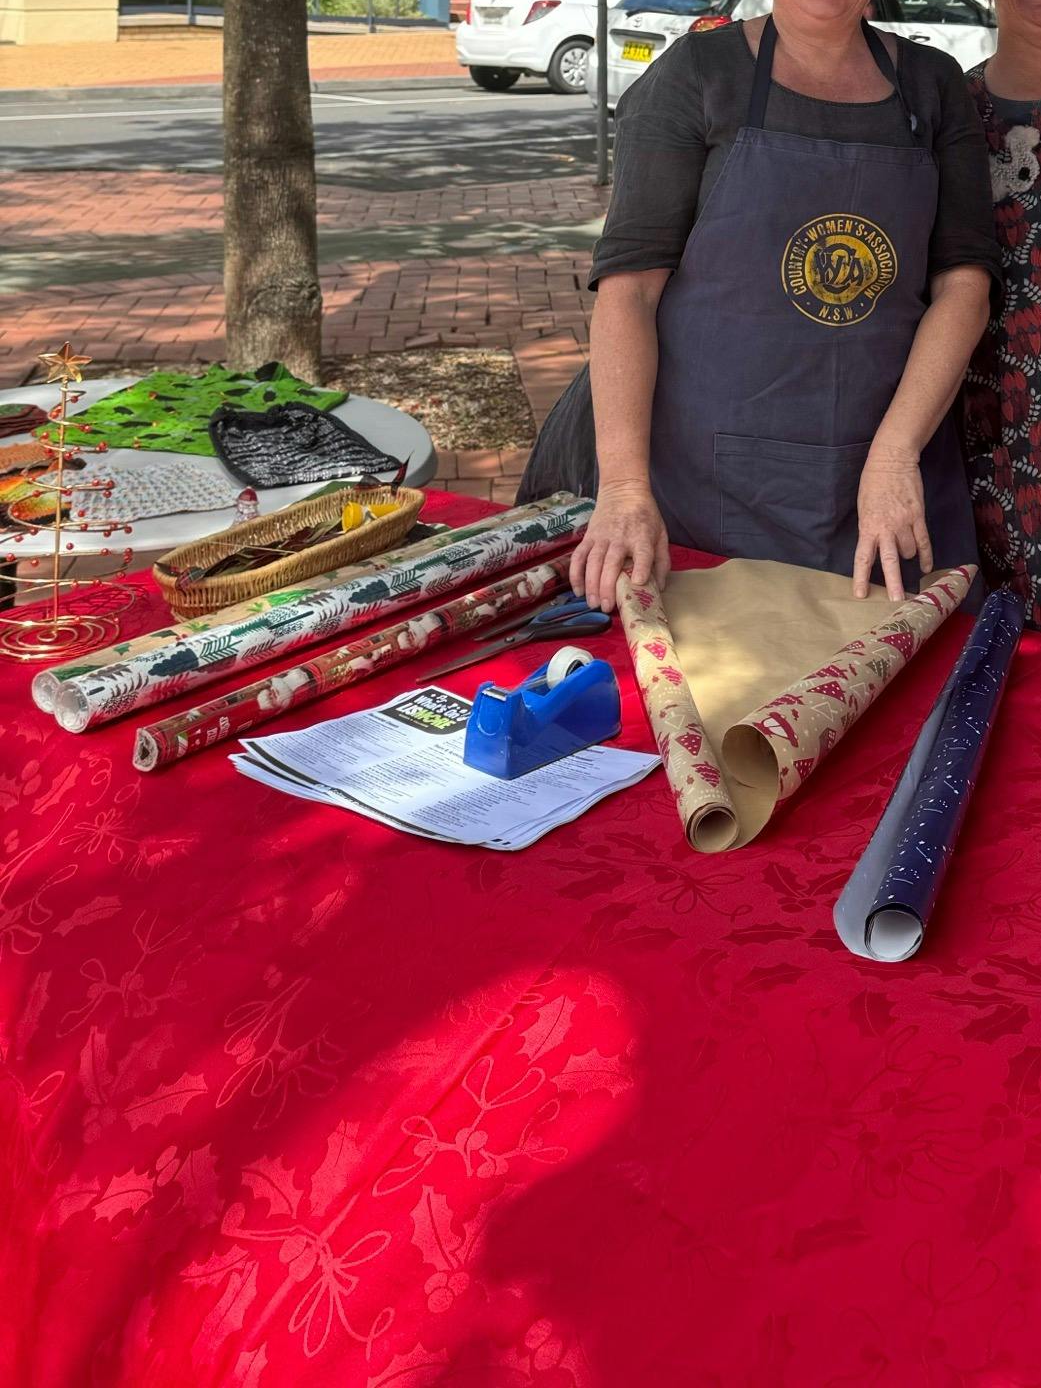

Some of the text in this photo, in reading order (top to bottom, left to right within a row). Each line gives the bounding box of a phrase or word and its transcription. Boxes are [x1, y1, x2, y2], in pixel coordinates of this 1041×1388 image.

[788, 219, 893, 299] COUNTRY WOMEN'S ASSOCIATION
[818, 305, 859, 321] N.S.W.
